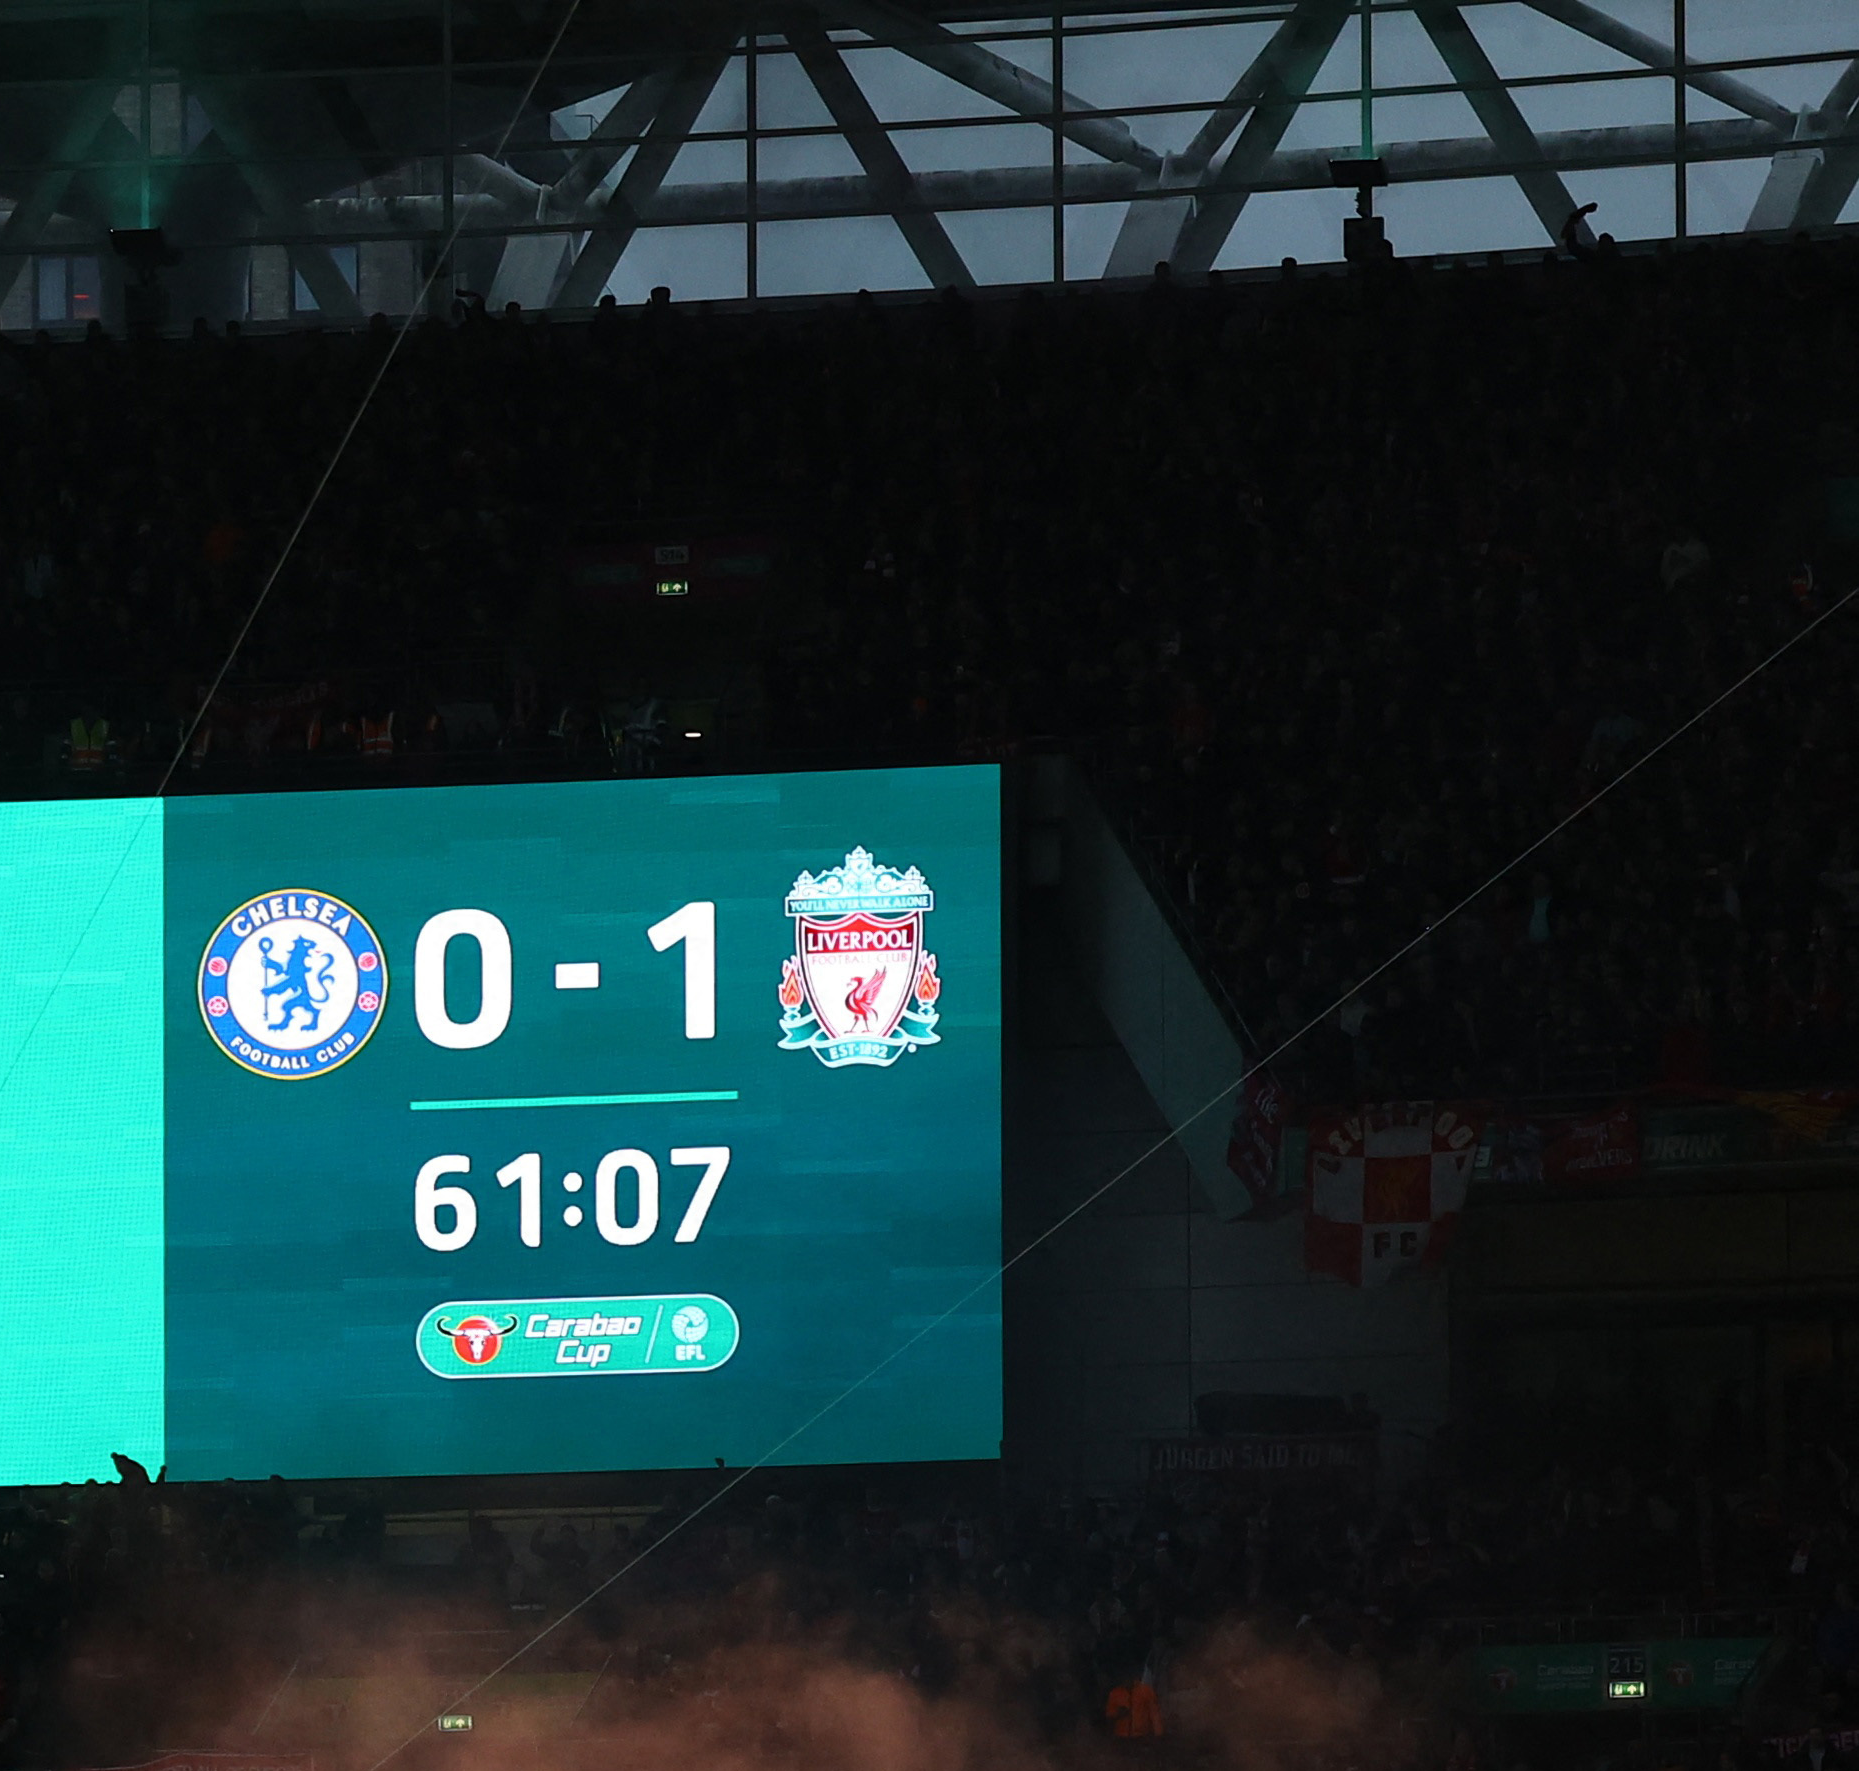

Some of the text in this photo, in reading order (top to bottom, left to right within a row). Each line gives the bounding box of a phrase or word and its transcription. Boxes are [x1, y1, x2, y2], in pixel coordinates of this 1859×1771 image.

[891, 895, 929, 908] ALONE
[232, 896, 352, 937] CHELSEA
[807, 929, 912, 951] LIVERPOOL
[414, 908, 513, 1049] 0
[647, 901, 716, 1039] 1
[230, 1031, 356, 1070] FOOTBALL CLUB
[415, 1146, 731, 1253] 61:07
[524, 1313, 642, 1340] Carabao
[555, 1340, 612, 1367] Cup
[675, 1344, 706, 1362] EFL
[1609, 1655, 1646, 1675] 215
